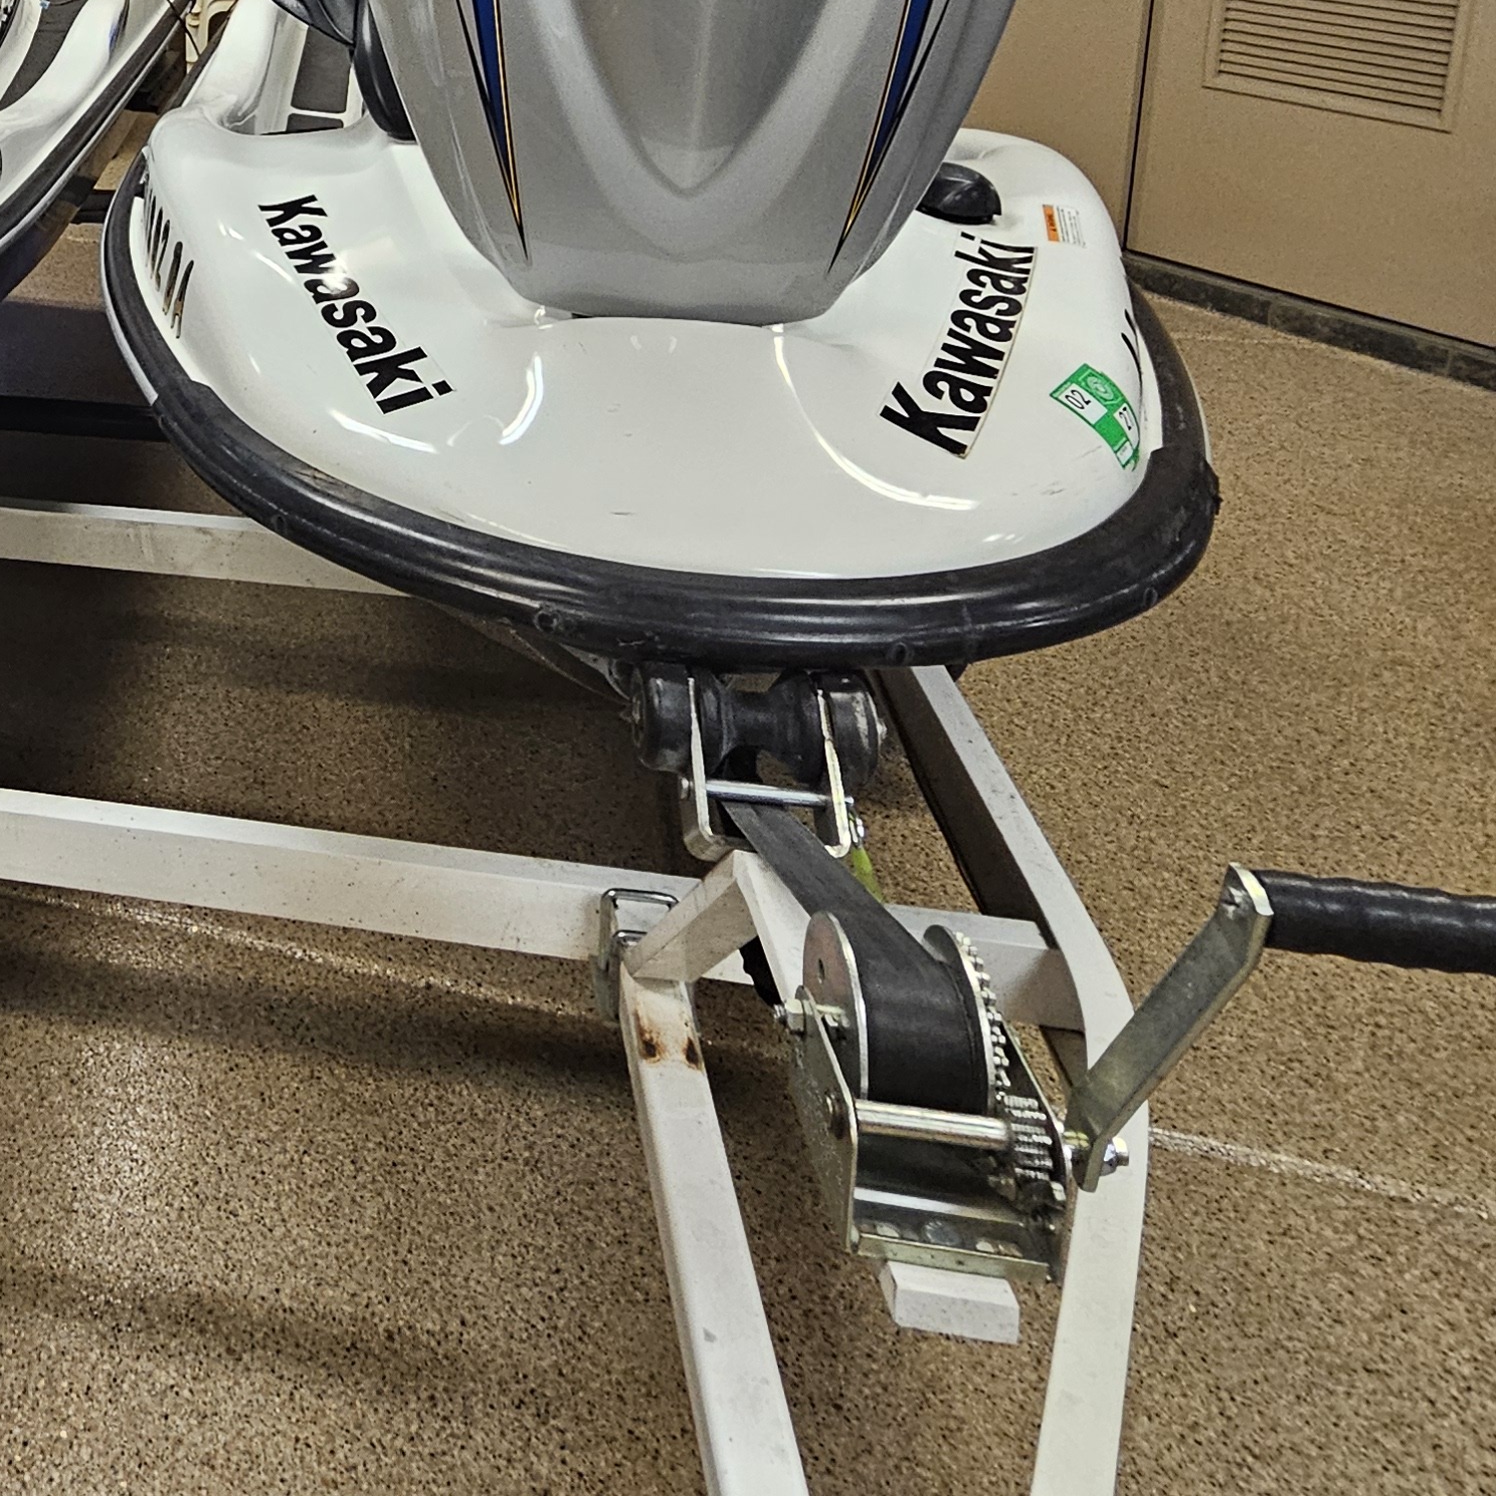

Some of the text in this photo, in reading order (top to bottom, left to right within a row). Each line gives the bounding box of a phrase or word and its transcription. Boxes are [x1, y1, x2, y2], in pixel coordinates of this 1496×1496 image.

[257, 194, 454, 415] Kawasaki
[879, 231, 1035, 457] Kawasaki
[1064, 389, 1092, 410] 02
